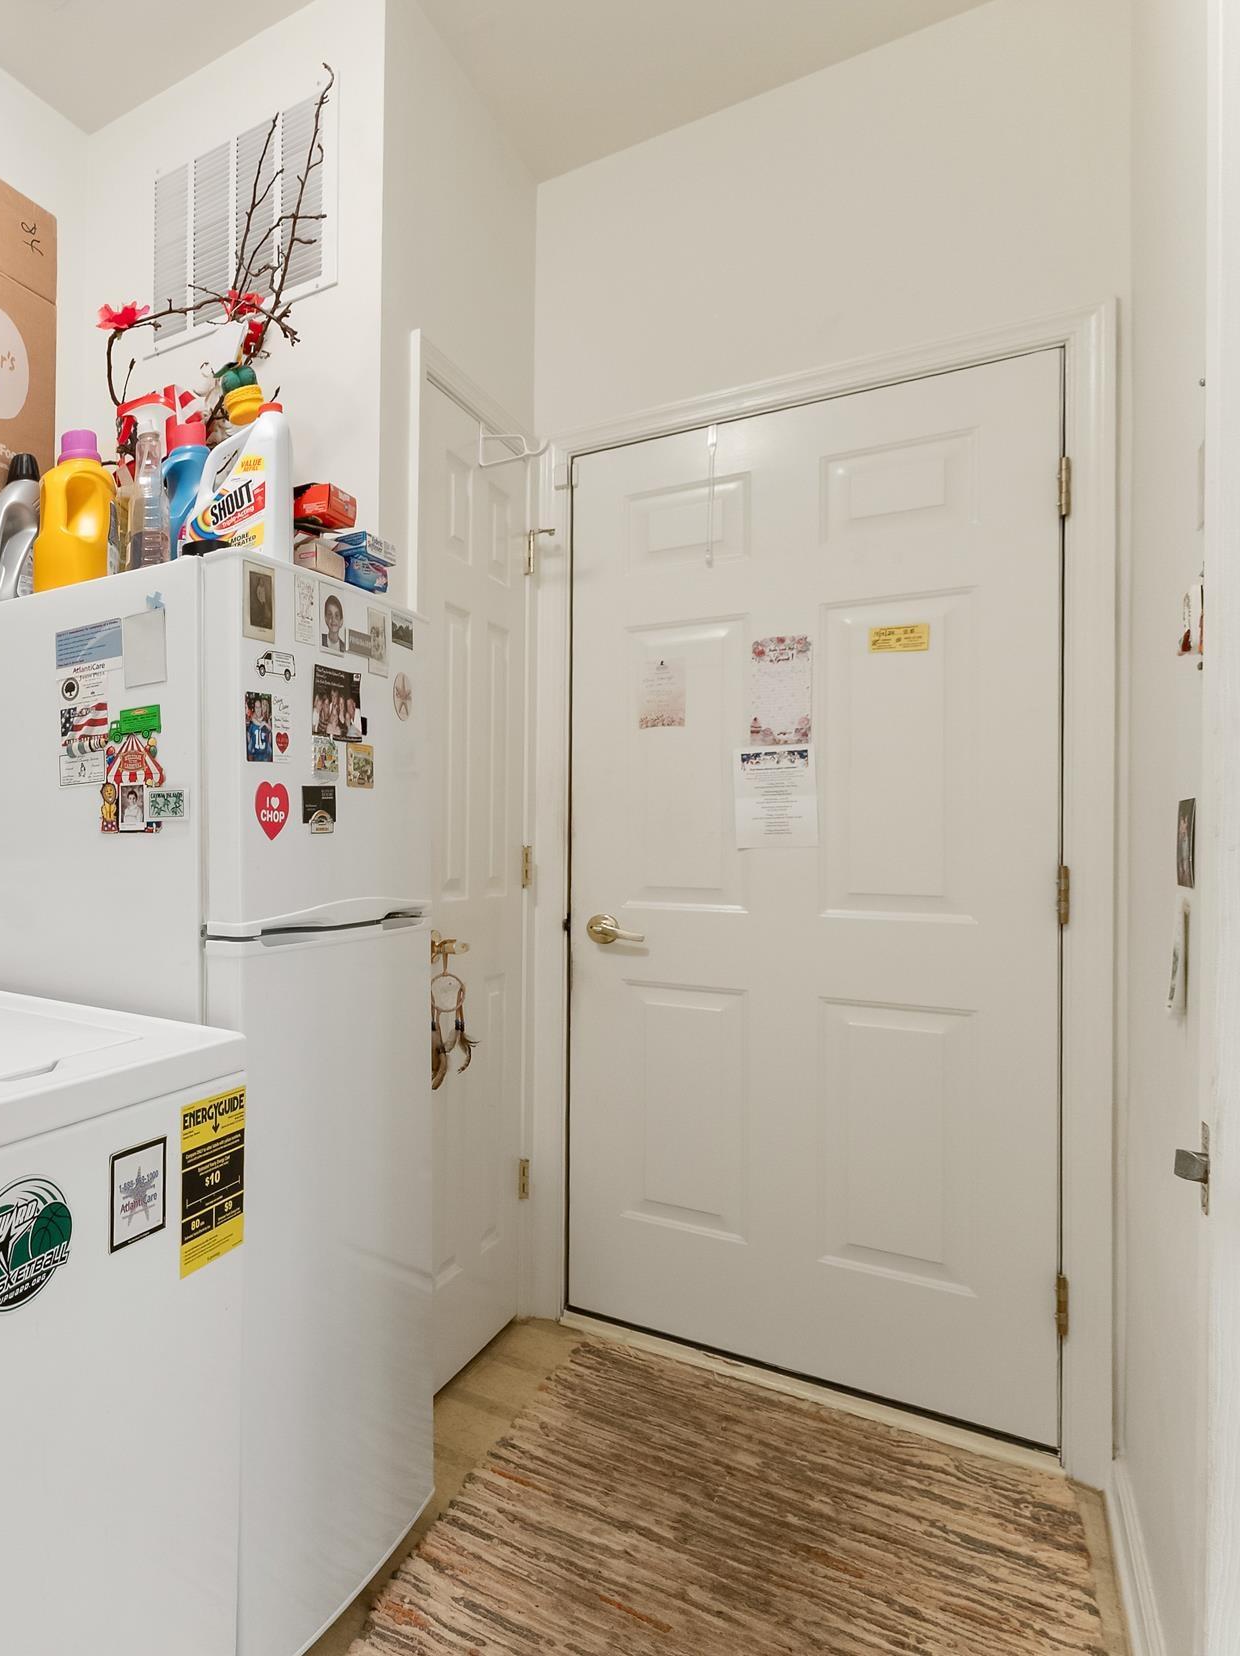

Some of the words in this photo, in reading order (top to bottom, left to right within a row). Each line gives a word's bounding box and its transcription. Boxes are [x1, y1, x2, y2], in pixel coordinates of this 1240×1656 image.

[241, 458, 262, 468] VALUE
[210, 479, 253, 526] SHOUT
[230, 532, 250, 544] MORE
[232, 534, 257, 547] TRATED
[72, 663, 106, 674] AtlantiCare
[266, 796, 270, 807] I
[260, 809, 285, 822] CHOP
[183, 1093, 245, 1133] ENERGYGUIDE
[204, 1170, 221, 1187] $10
[120, 1192, 158, 1215] AtlantiCare
[224, 1200, 233, 1212] $9
[191, 1219, 200, 1231] 80
